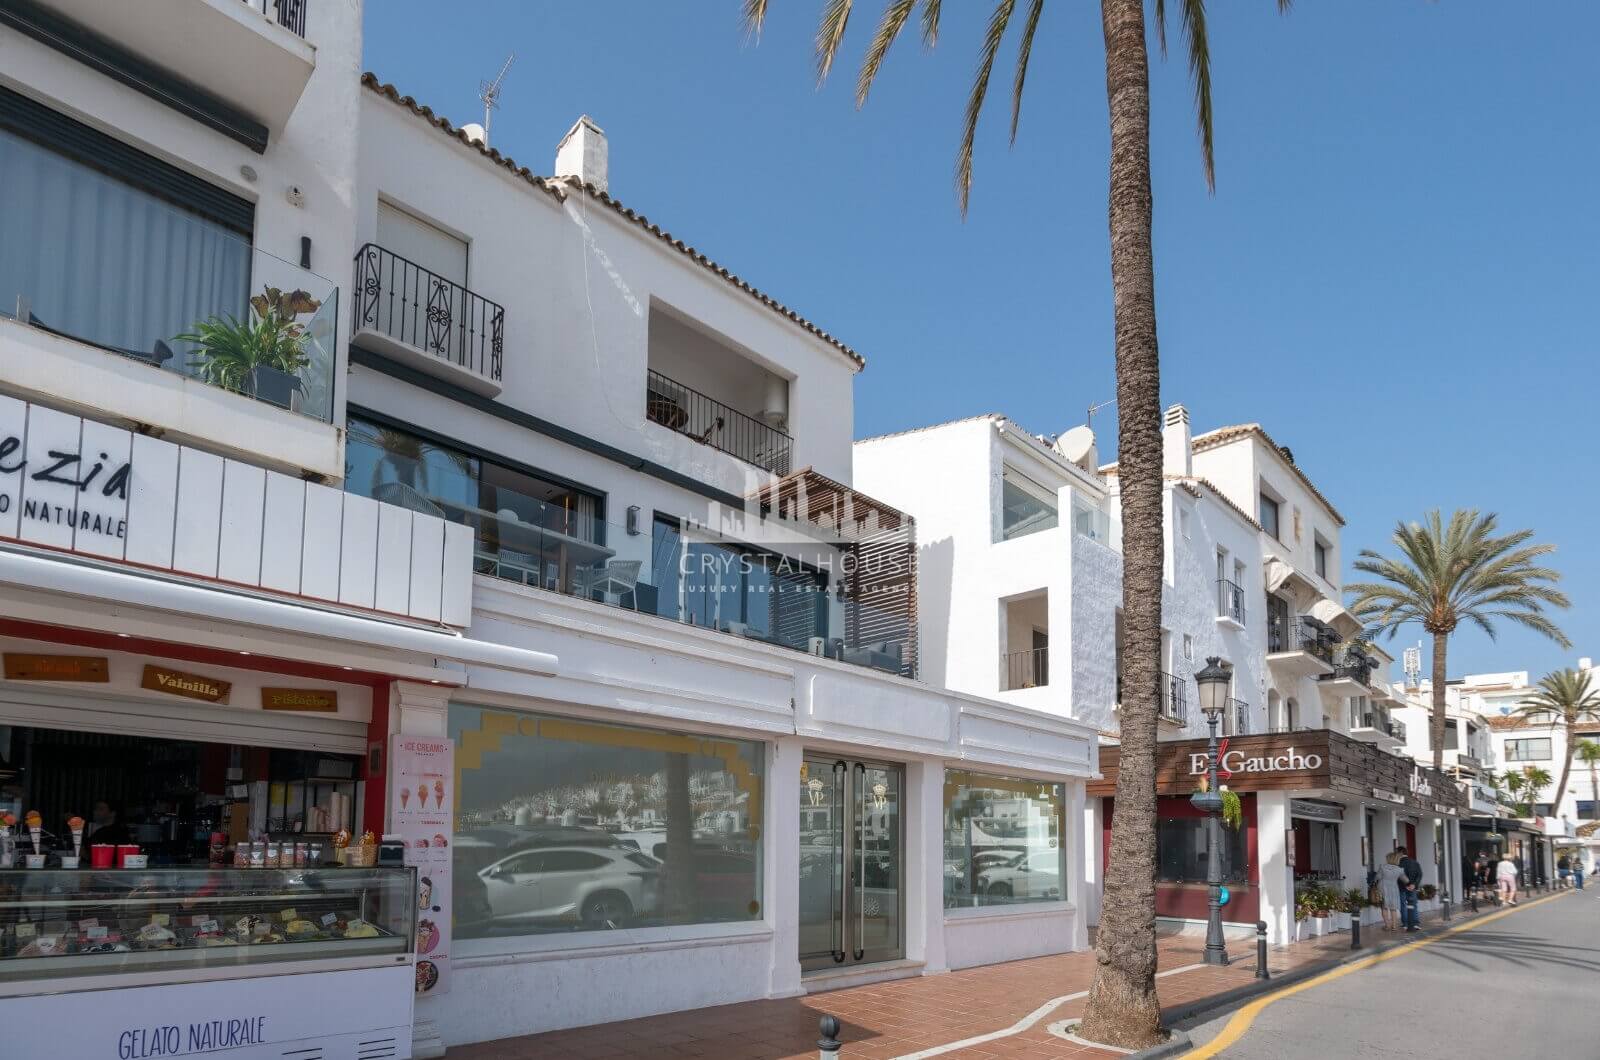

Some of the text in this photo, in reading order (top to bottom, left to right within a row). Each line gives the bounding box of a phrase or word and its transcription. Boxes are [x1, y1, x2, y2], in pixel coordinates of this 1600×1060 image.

[24, 500, 126, 538] NATURALE
[156, 673, 219, 696] Vainilla
[404, 742, 444, 753] ICE CREAMS
[1222, 747, 1322, 773] Gaucho
[118, 1016, 266, 1060] GELATO NATURALE
